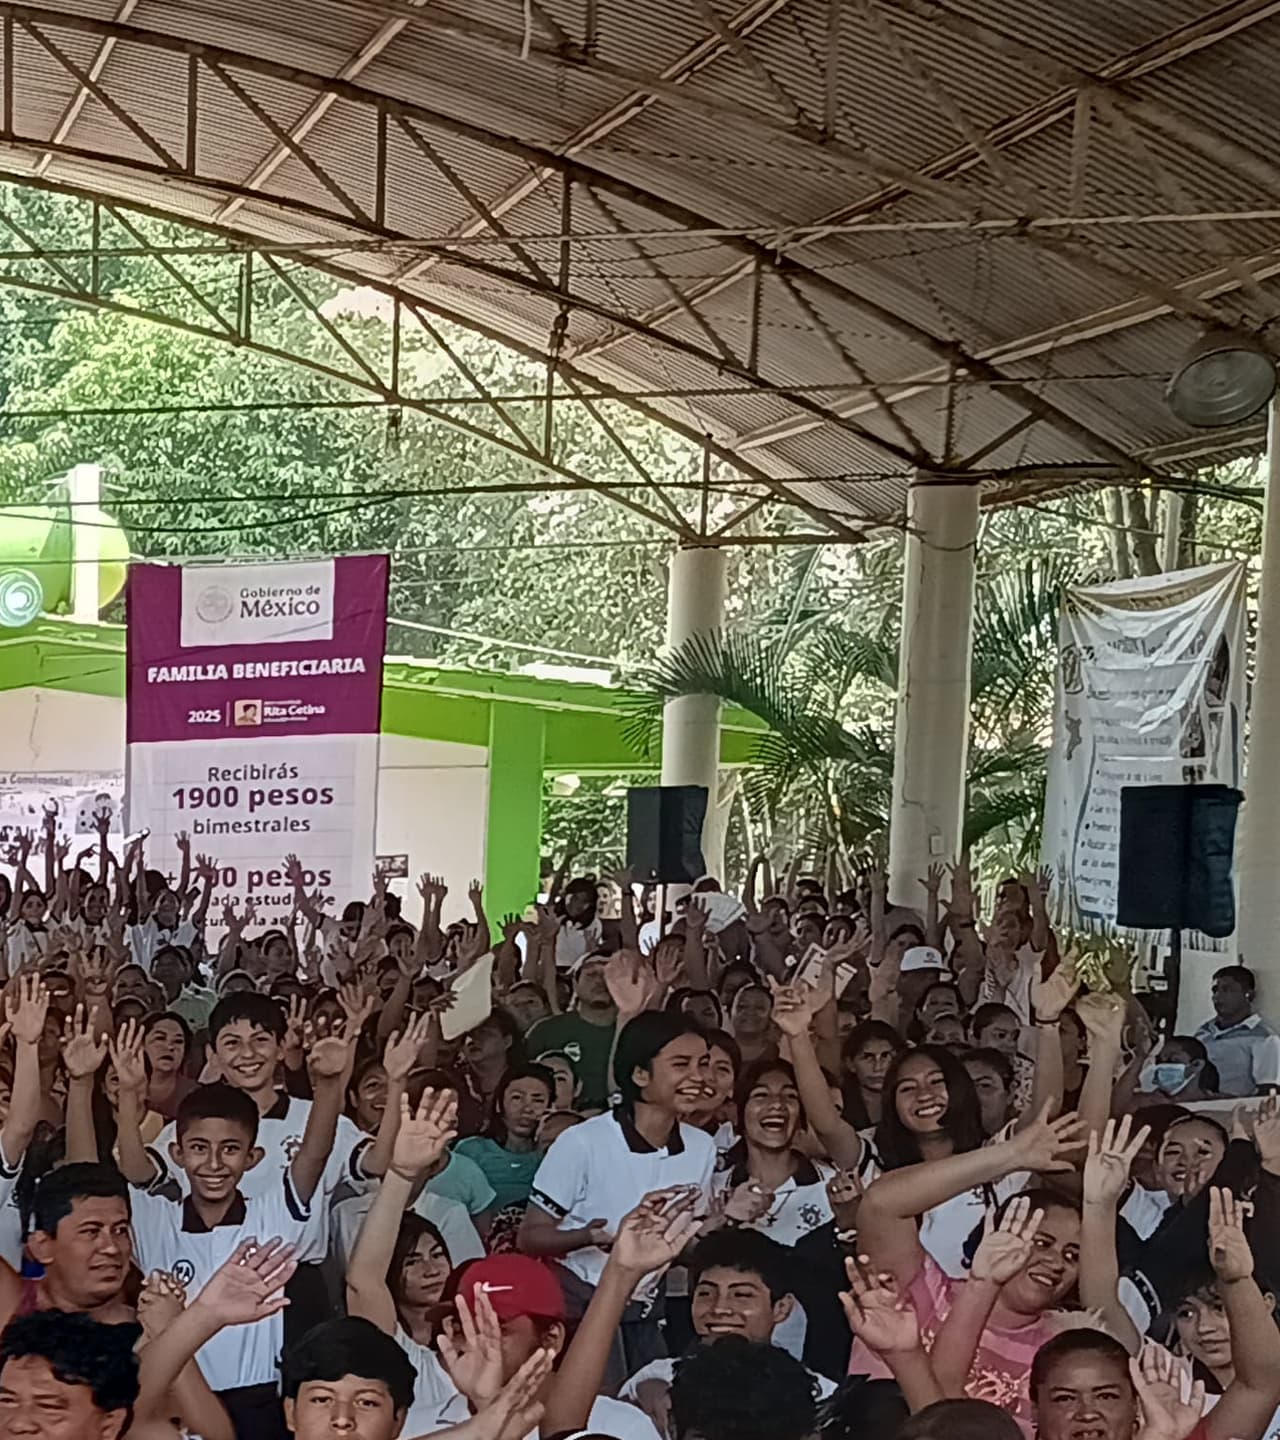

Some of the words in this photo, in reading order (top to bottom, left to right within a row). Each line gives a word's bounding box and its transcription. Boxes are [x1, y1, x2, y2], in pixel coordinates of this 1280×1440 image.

[240, 586, 302, 598] Gobierno
[305, 585, 321, 596] de
[239, 598, 321, 619] México
[147, 664, 228, 684] FAMILIA
[232, 657, 367, 679] BENEFICIARIA
[187, 709, 221, 724] 2025
[263, 706, 287, 717] Rita
[288, 704, 326, 716] Cetina
[207, 762, 299, 782] Recibirás
[172, 786, 239, 810] 1900
[248, 787, 334, 813] pesos
[193, 816, 311, 835] bimestrales
